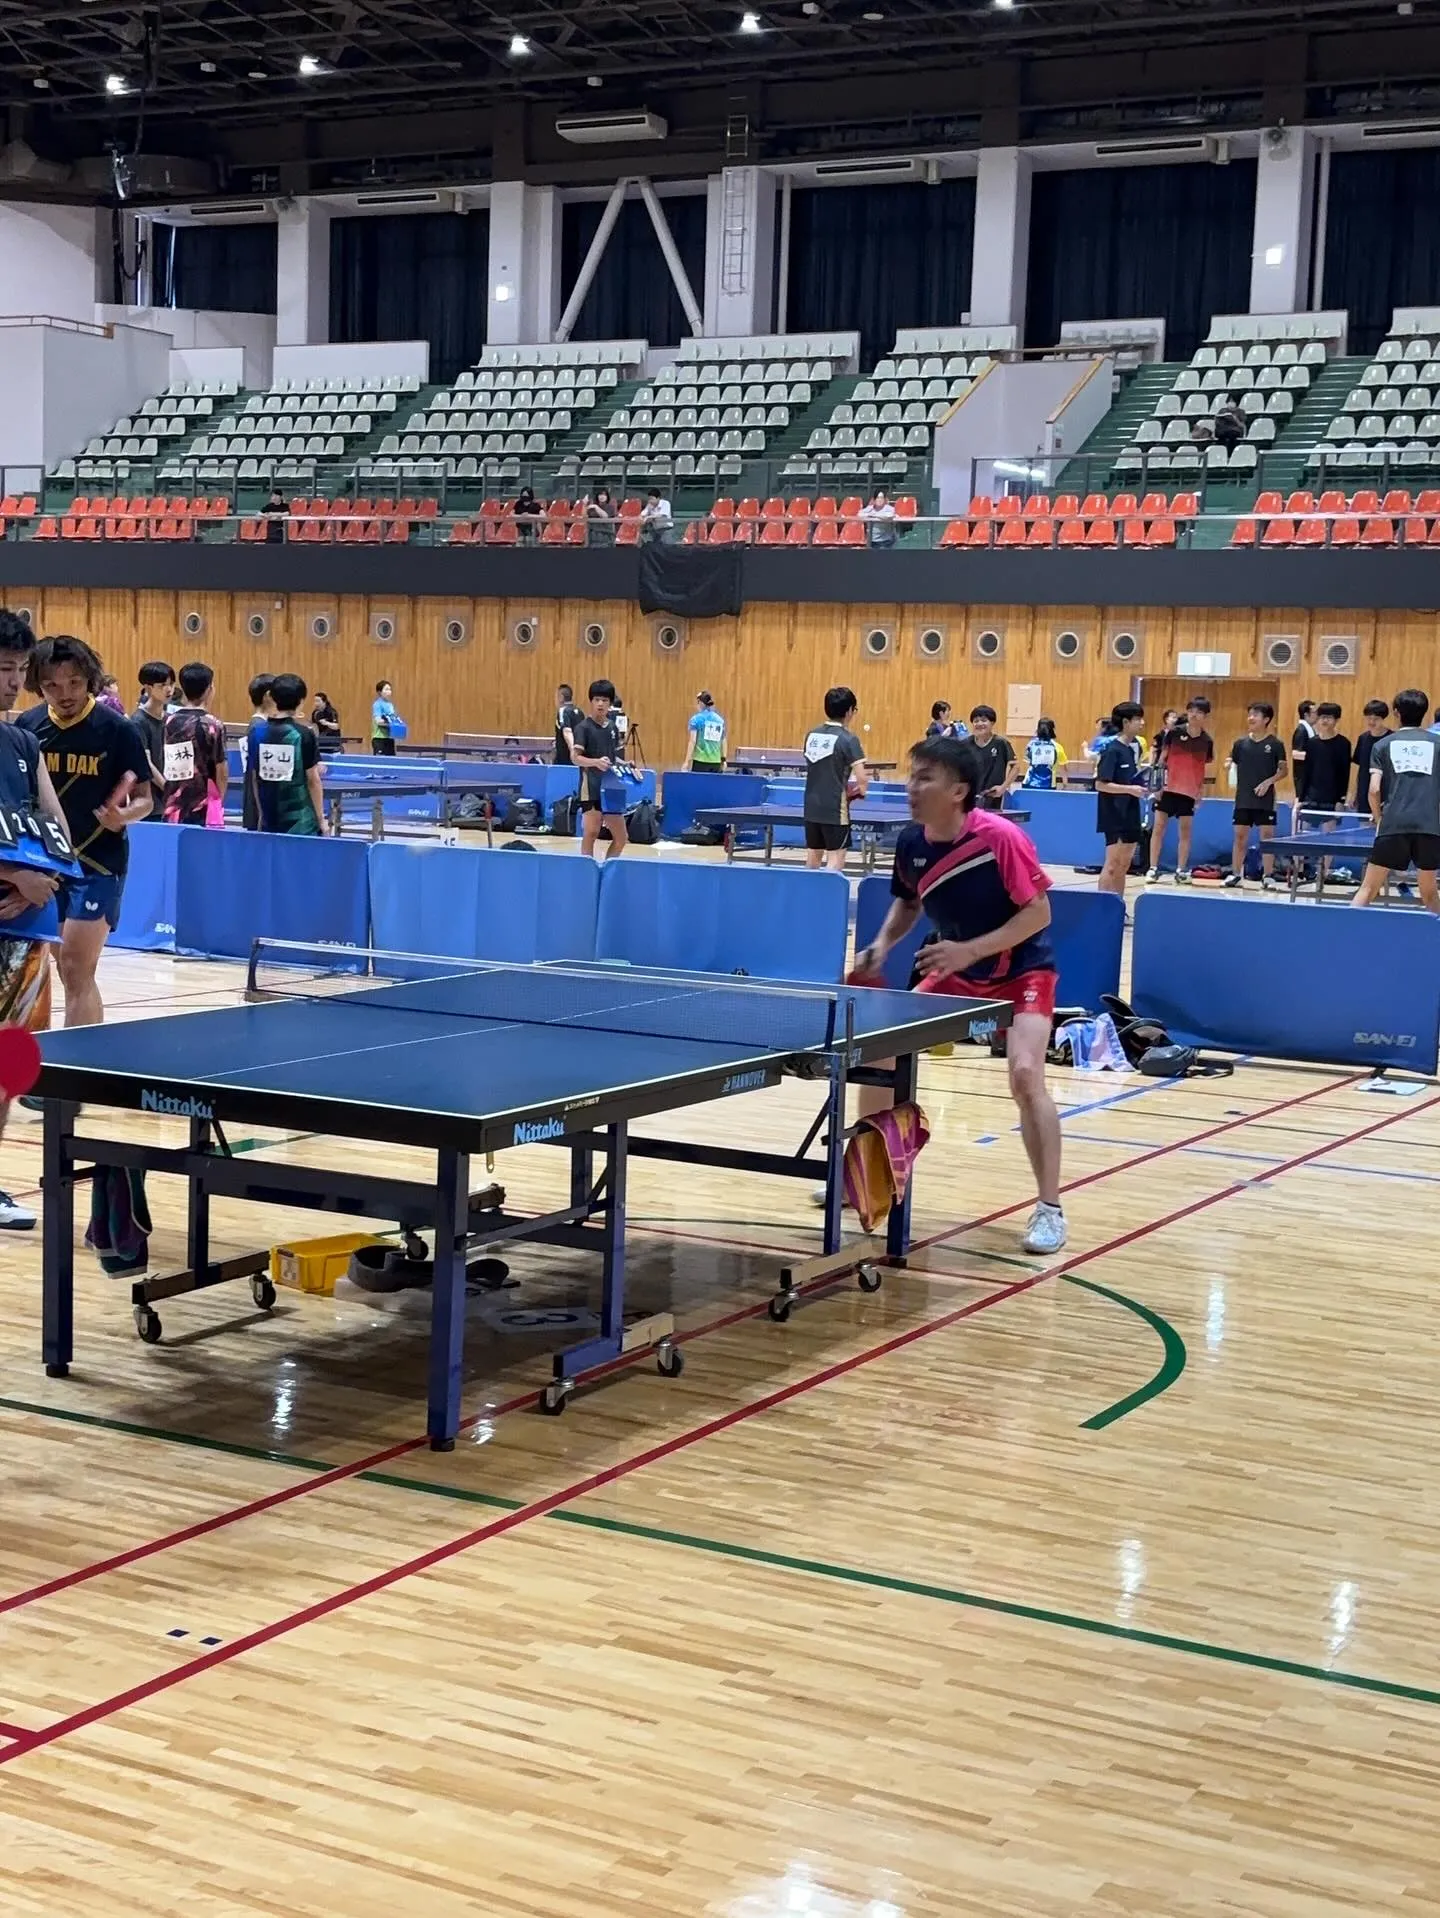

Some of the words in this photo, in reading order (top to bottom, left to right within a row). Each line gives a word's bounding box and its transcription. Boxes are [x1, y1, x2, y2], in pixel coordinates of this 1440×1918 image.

[261, 749, 292, 763] 中山
[11, 812, 27, 833] 2
[27, 816, 41, 836] 0
[45, 821, 70, 854] 5
[141, 1088, 214, 1120] Nittaku
[513, 1116, 566, 1146] Nittaku
